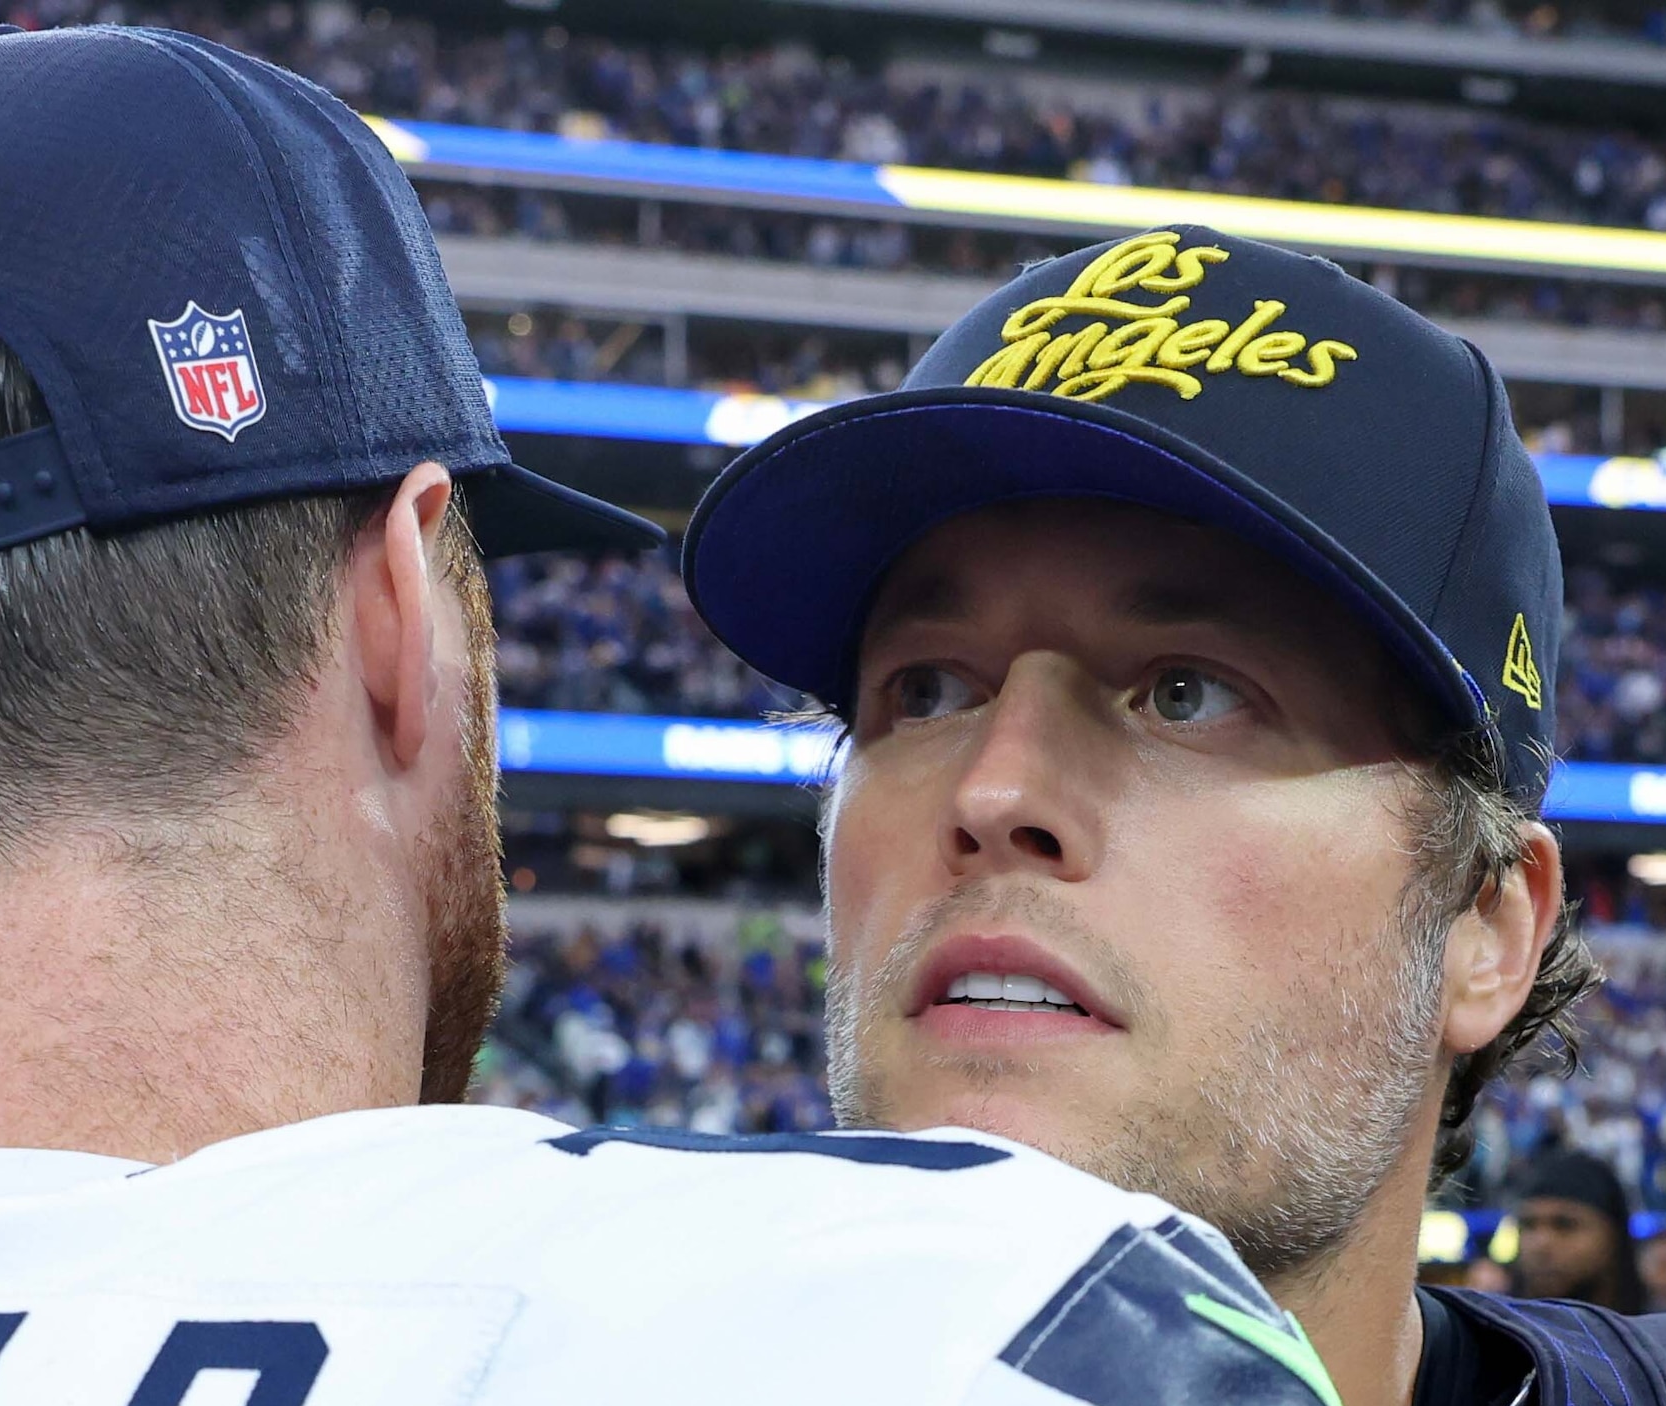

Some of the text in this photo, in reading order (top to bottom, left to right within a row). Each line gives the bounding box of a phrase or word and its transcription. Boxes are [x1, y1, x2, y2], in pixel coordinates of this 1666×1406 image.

[1000, 230, 1231, 345] Los
[177, 360, 258, 422] NFL
[962, 299, 1359, 401] Angeles
